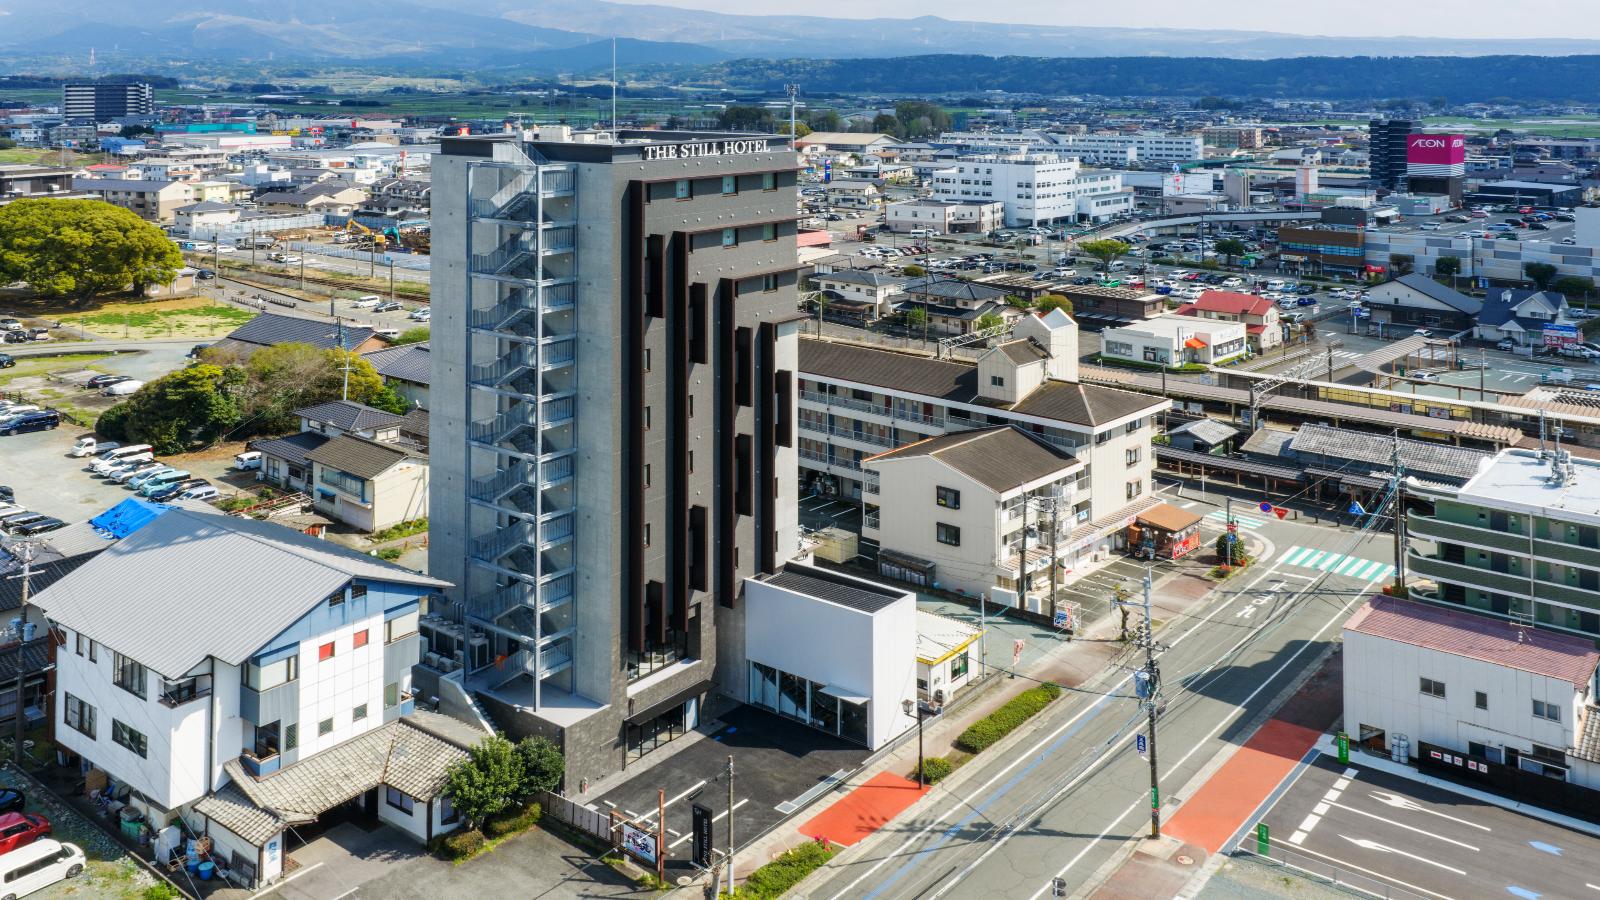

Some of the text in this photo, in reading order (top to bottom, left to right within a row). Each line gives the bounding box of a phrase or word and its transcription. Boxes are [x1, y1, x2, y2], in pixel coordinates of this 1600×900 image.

[645, 140, 771, 160] THE STILL HOTEL
[1235, 580, 1288, 618] 止まれ
